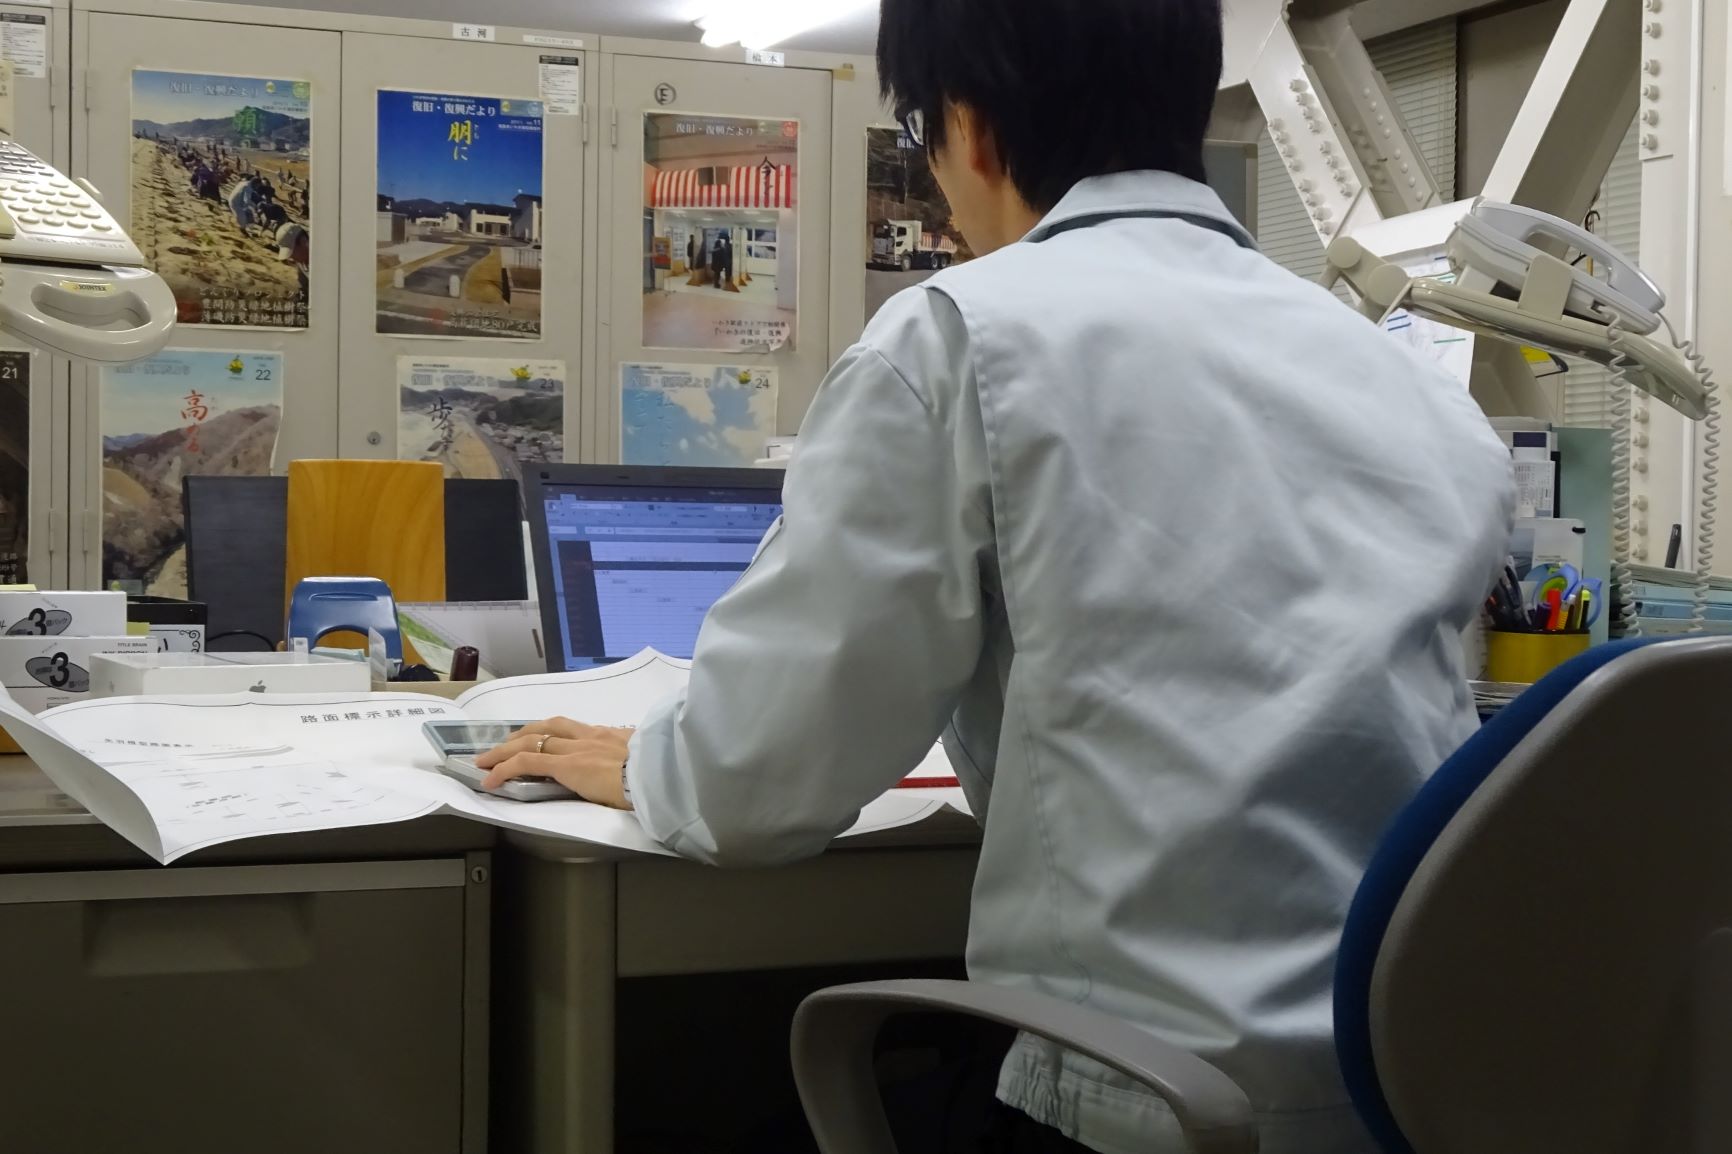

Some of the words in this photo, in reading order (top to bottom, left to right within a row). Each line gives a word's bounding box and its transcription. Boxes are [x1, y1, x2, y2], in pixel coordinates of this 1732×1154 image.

[412, 101, 496, 117] 復旧・復興だより
[2, 366, 18, 379] 21
[255, 369, 271, 381] 22
[539, 379, 555, 389] 23
[755, 378, 770, 389] 24
[28, 608, 47, 635] 3
[50, 652, 69, 687] 3
